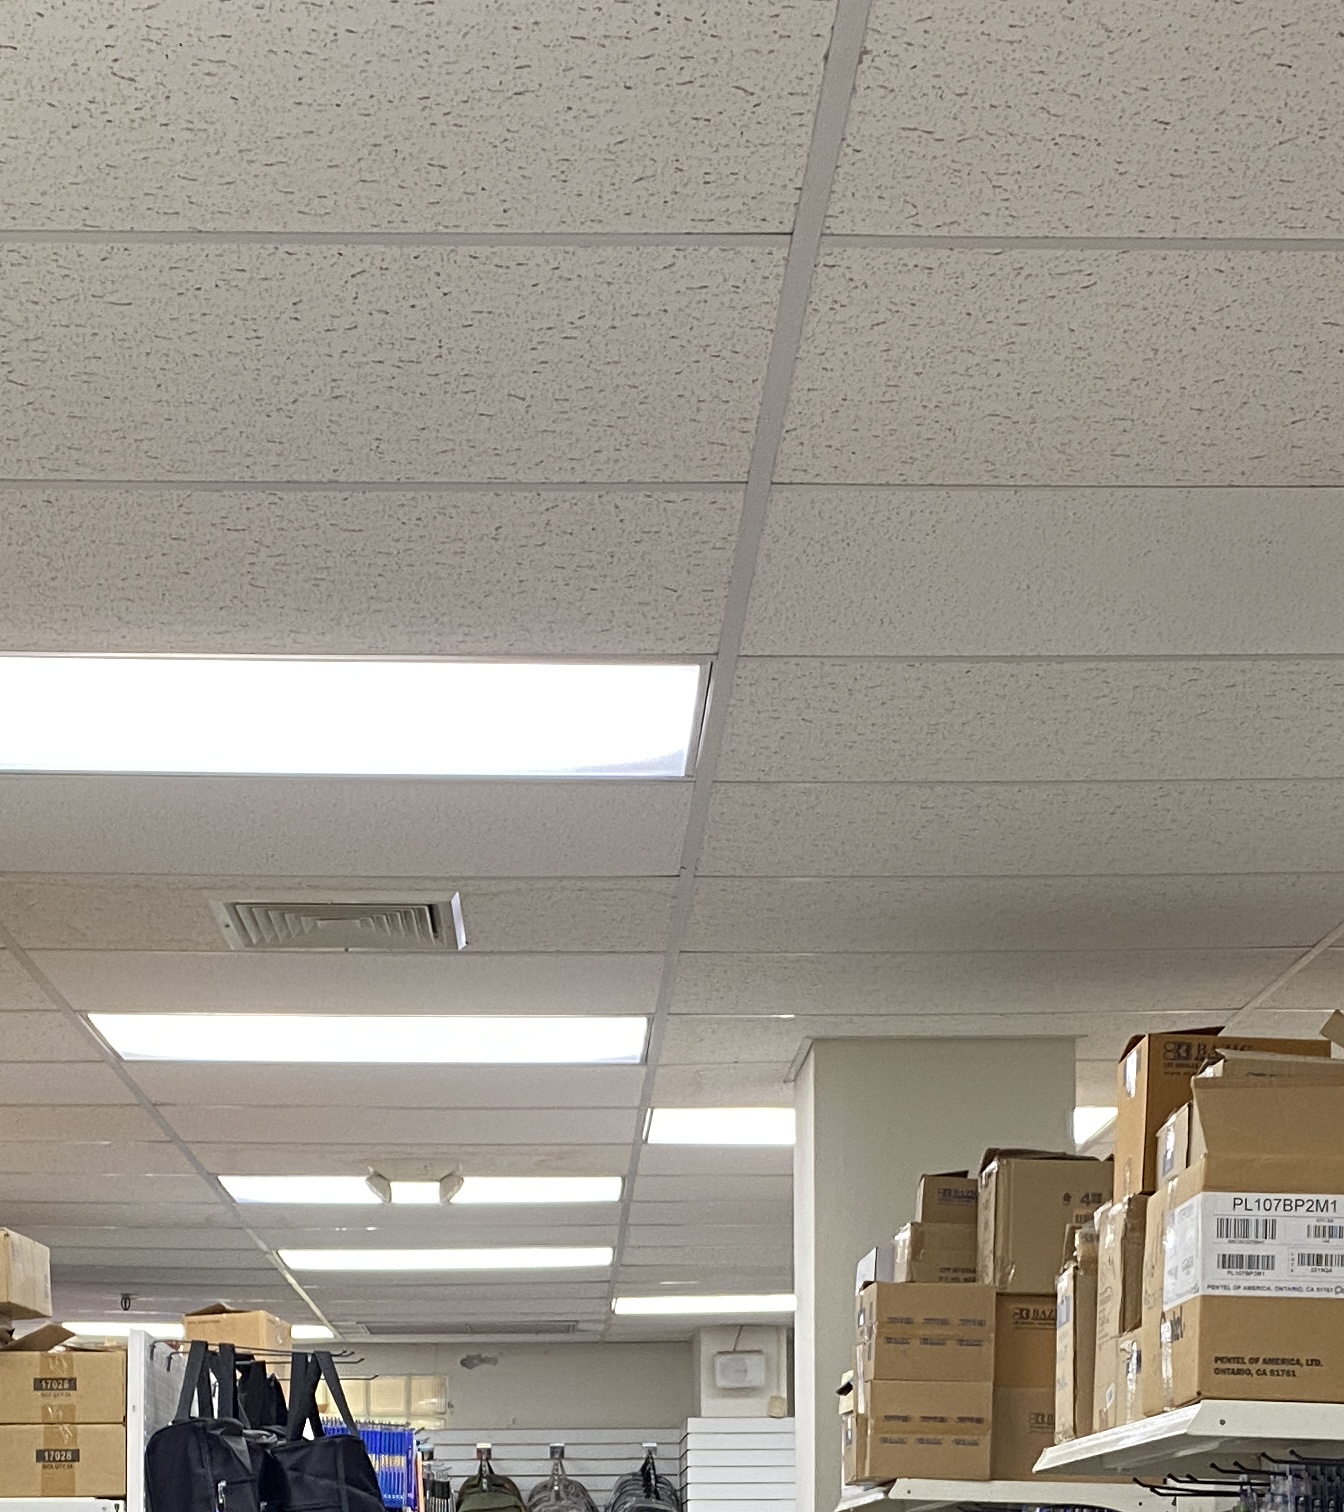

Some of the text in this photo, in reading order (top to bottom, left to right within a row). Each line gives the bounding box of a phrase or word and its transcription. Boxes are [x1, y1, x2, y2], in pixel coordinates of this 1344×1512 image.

[1233, 1197, 1337, 1213] PL107BP2M1
[1214, 1356, 1323, 1367] PENTEL OF AMERICA, LTD.
[1214, 1368, 1253, 1378] ONTARIO,
[1256, 1369, 1267, 1377] CA
[41, 1379, 70, 1389] 17028
[44, 1451, 72, 1461] 17028
